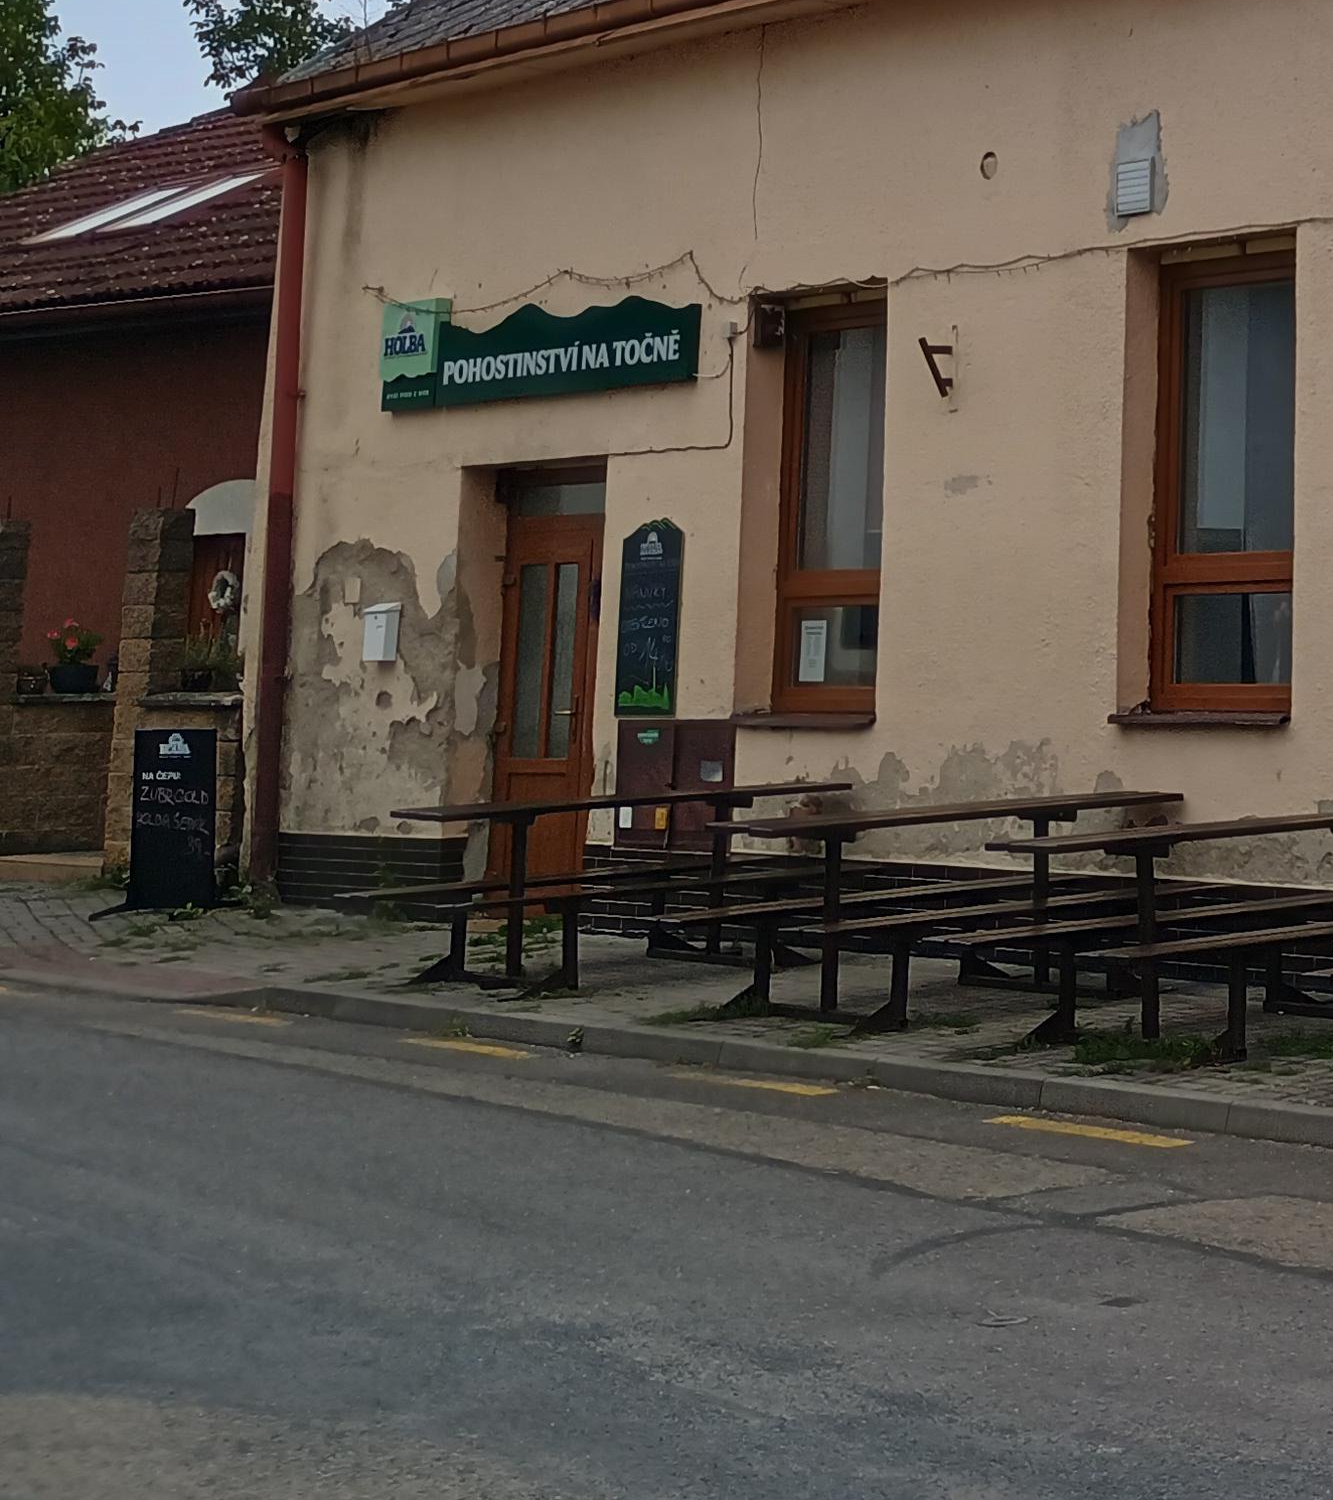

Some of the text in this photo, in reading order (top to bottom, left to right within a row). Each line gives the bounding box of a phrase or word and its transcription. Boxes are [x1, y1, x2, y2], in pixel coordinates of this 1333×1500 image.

[383, 334, 427, 357] HOLBA
[442, 329, 681, 386] POHOSTINSTVÍ NA TOČNĚ
